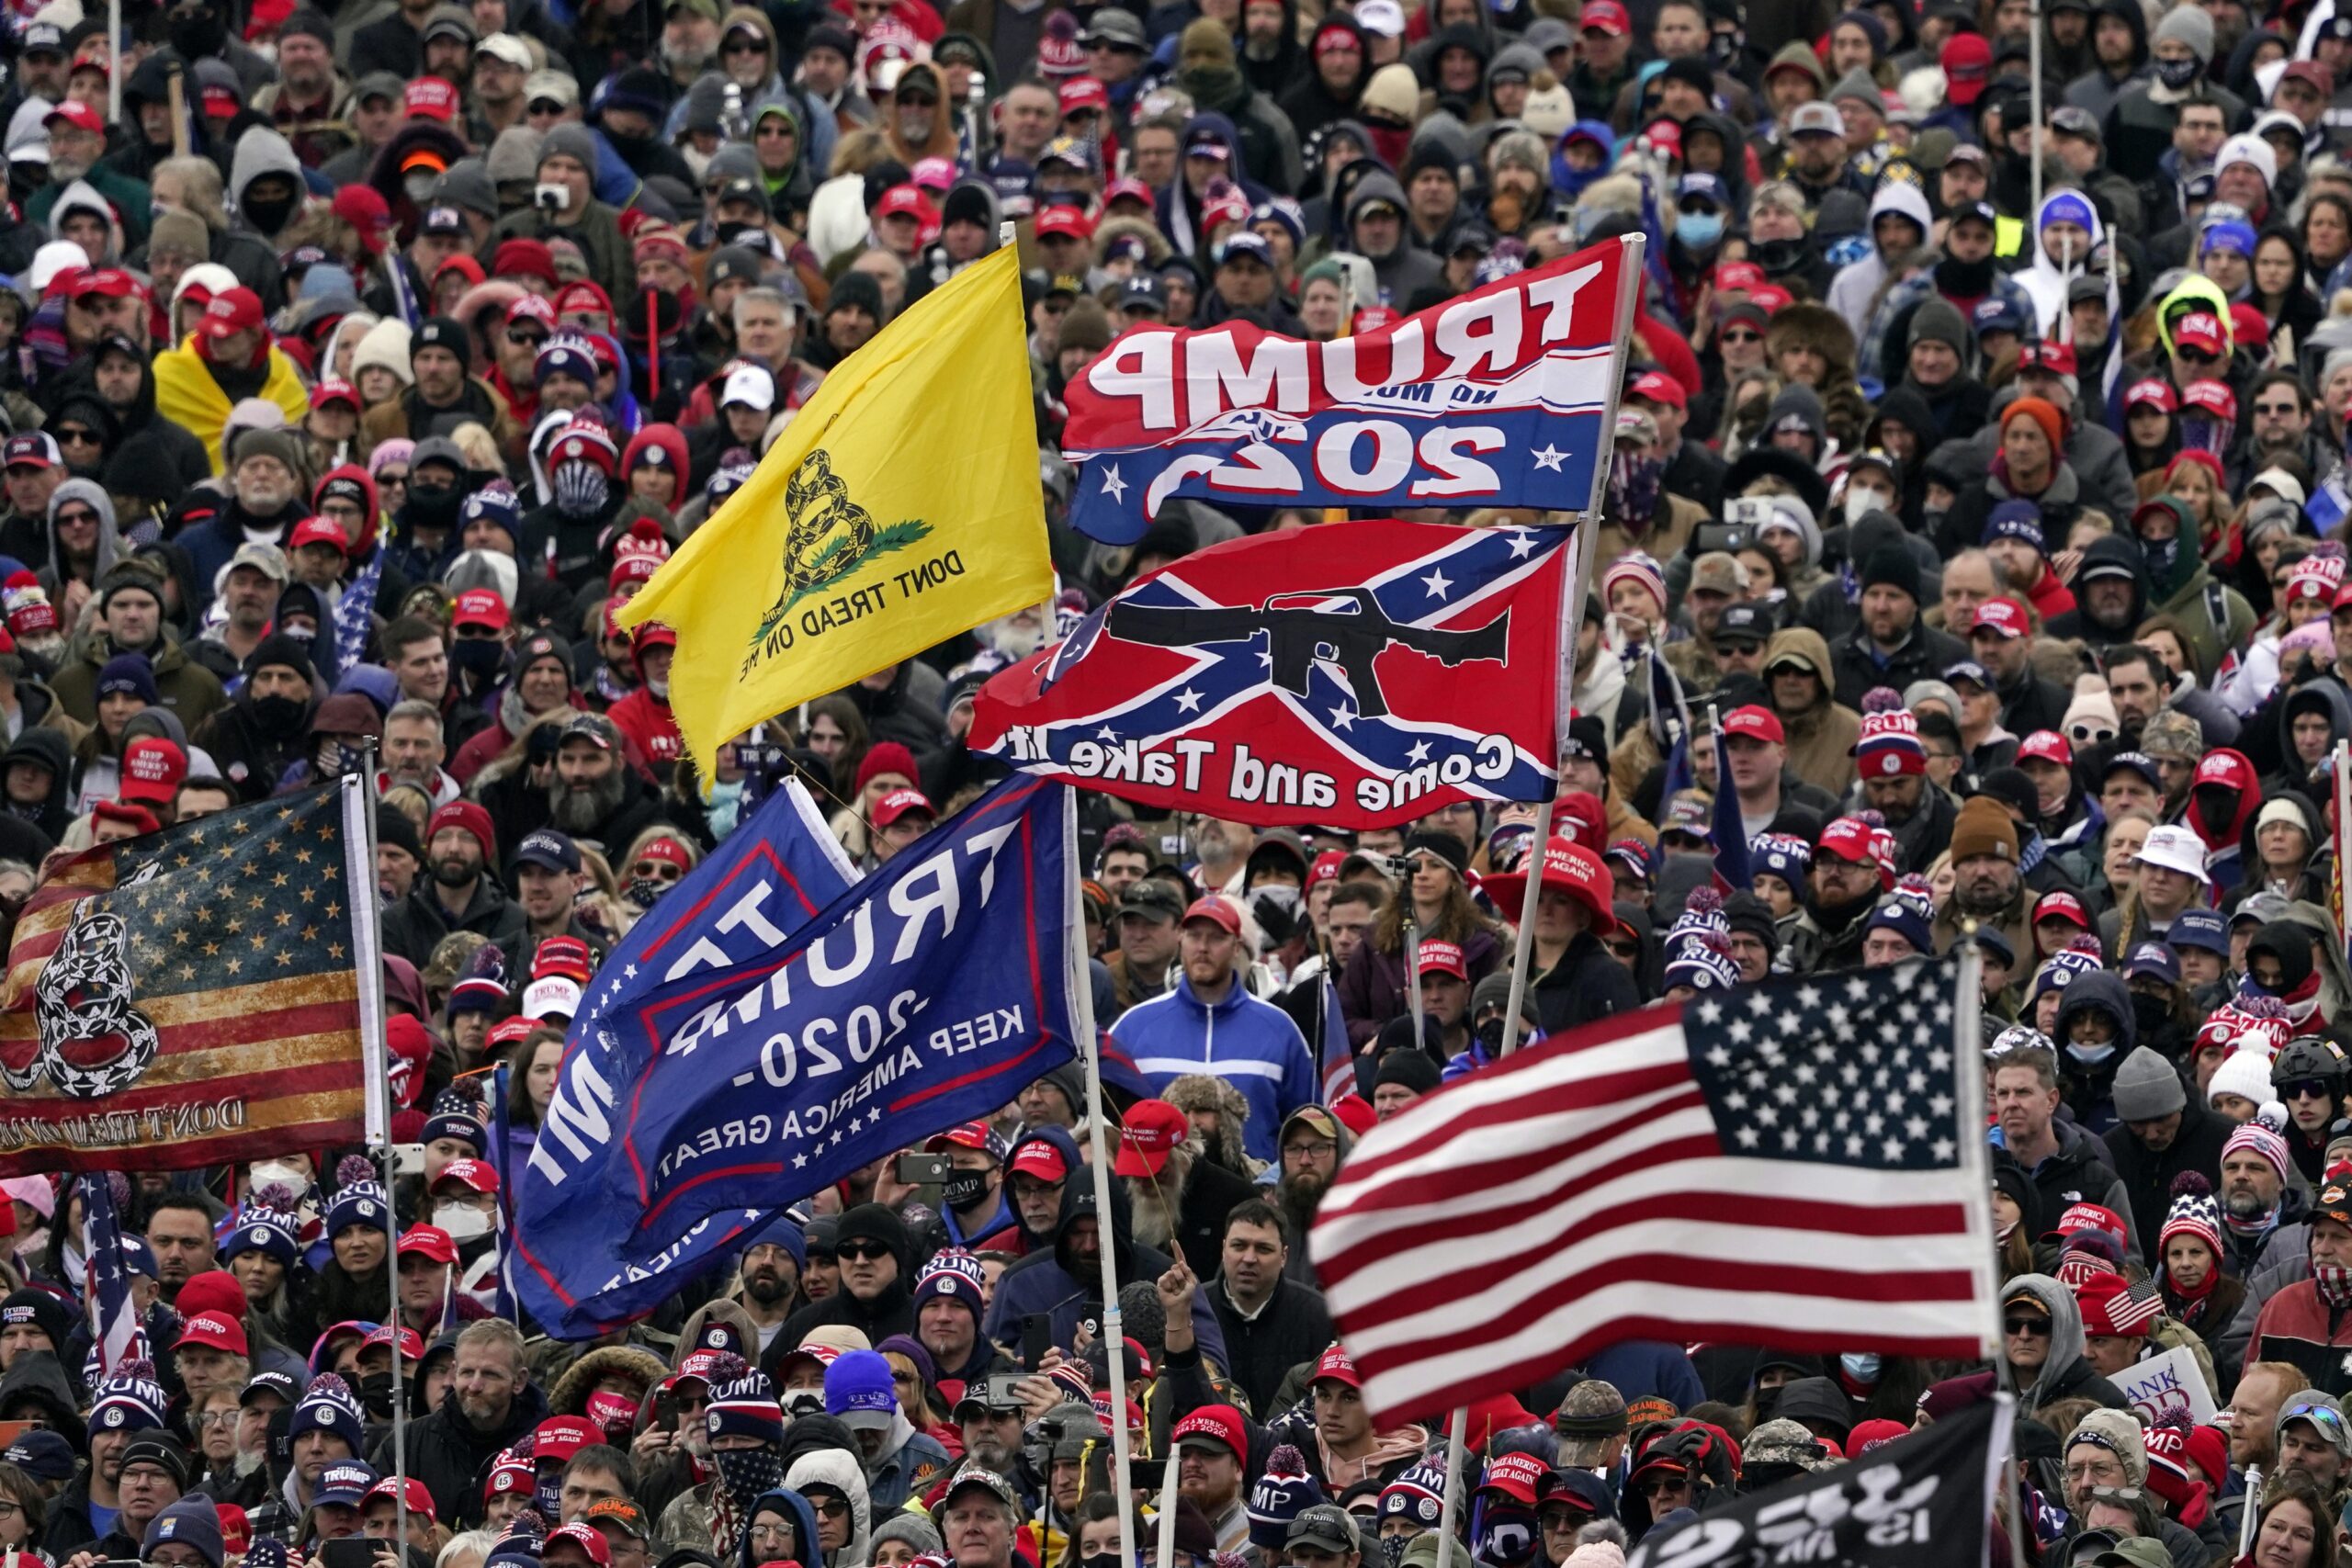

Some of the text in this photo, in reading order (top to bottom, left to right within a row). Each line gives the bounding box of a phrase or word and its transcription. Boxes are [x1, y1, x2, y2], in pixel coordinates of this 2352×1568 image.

[1544, 850, 1596, 878] AMERICA
[1549, 861, 1589, 883] AGAIN
[1429, 943, 1461, 955] AMERICA
[1435, 954, 1457, 964] AGAIN
[446, 1122, 474, 1133] TRUMP
[360, 1203, 373, 1213] 45
[254, 1231, 268, 1241] 45
[941, 1280, 953, 1291] 45
[3, 1306, 35, 1318] Trump
[186, 1318, 226, 1336] Trump
[710, 1334, 725, 1344] 45
[682, 1354, 714, 1368] Trum
[250, 1372, 293, 1385] BUFFALO
[319, 1410, 332, 1421] 45
[594, 1400, 633, 1419] WOMEN
[107, 1411, 120, 1423] 45
[710, 1416, 719, 1427] 45
[1192, 1417, 1228, 1433] AMERICA
[553, 1427, 584, 1437] AMERICA
[1200, 1425, 1227, 1438] 2020
[1507, 1458, 1542, 1476] AMERICA
[323, 1468, 370, 1484] TRUMP
[497, 1475, 509, 1486] 45
[1510, 1472, 1535, 1484] AGAIN
[587, 1496, 639, 1520] TRUMP
[1389, 1497, 1402, 1508] 45
[556, 1526, 594, 1540] AMERICA
